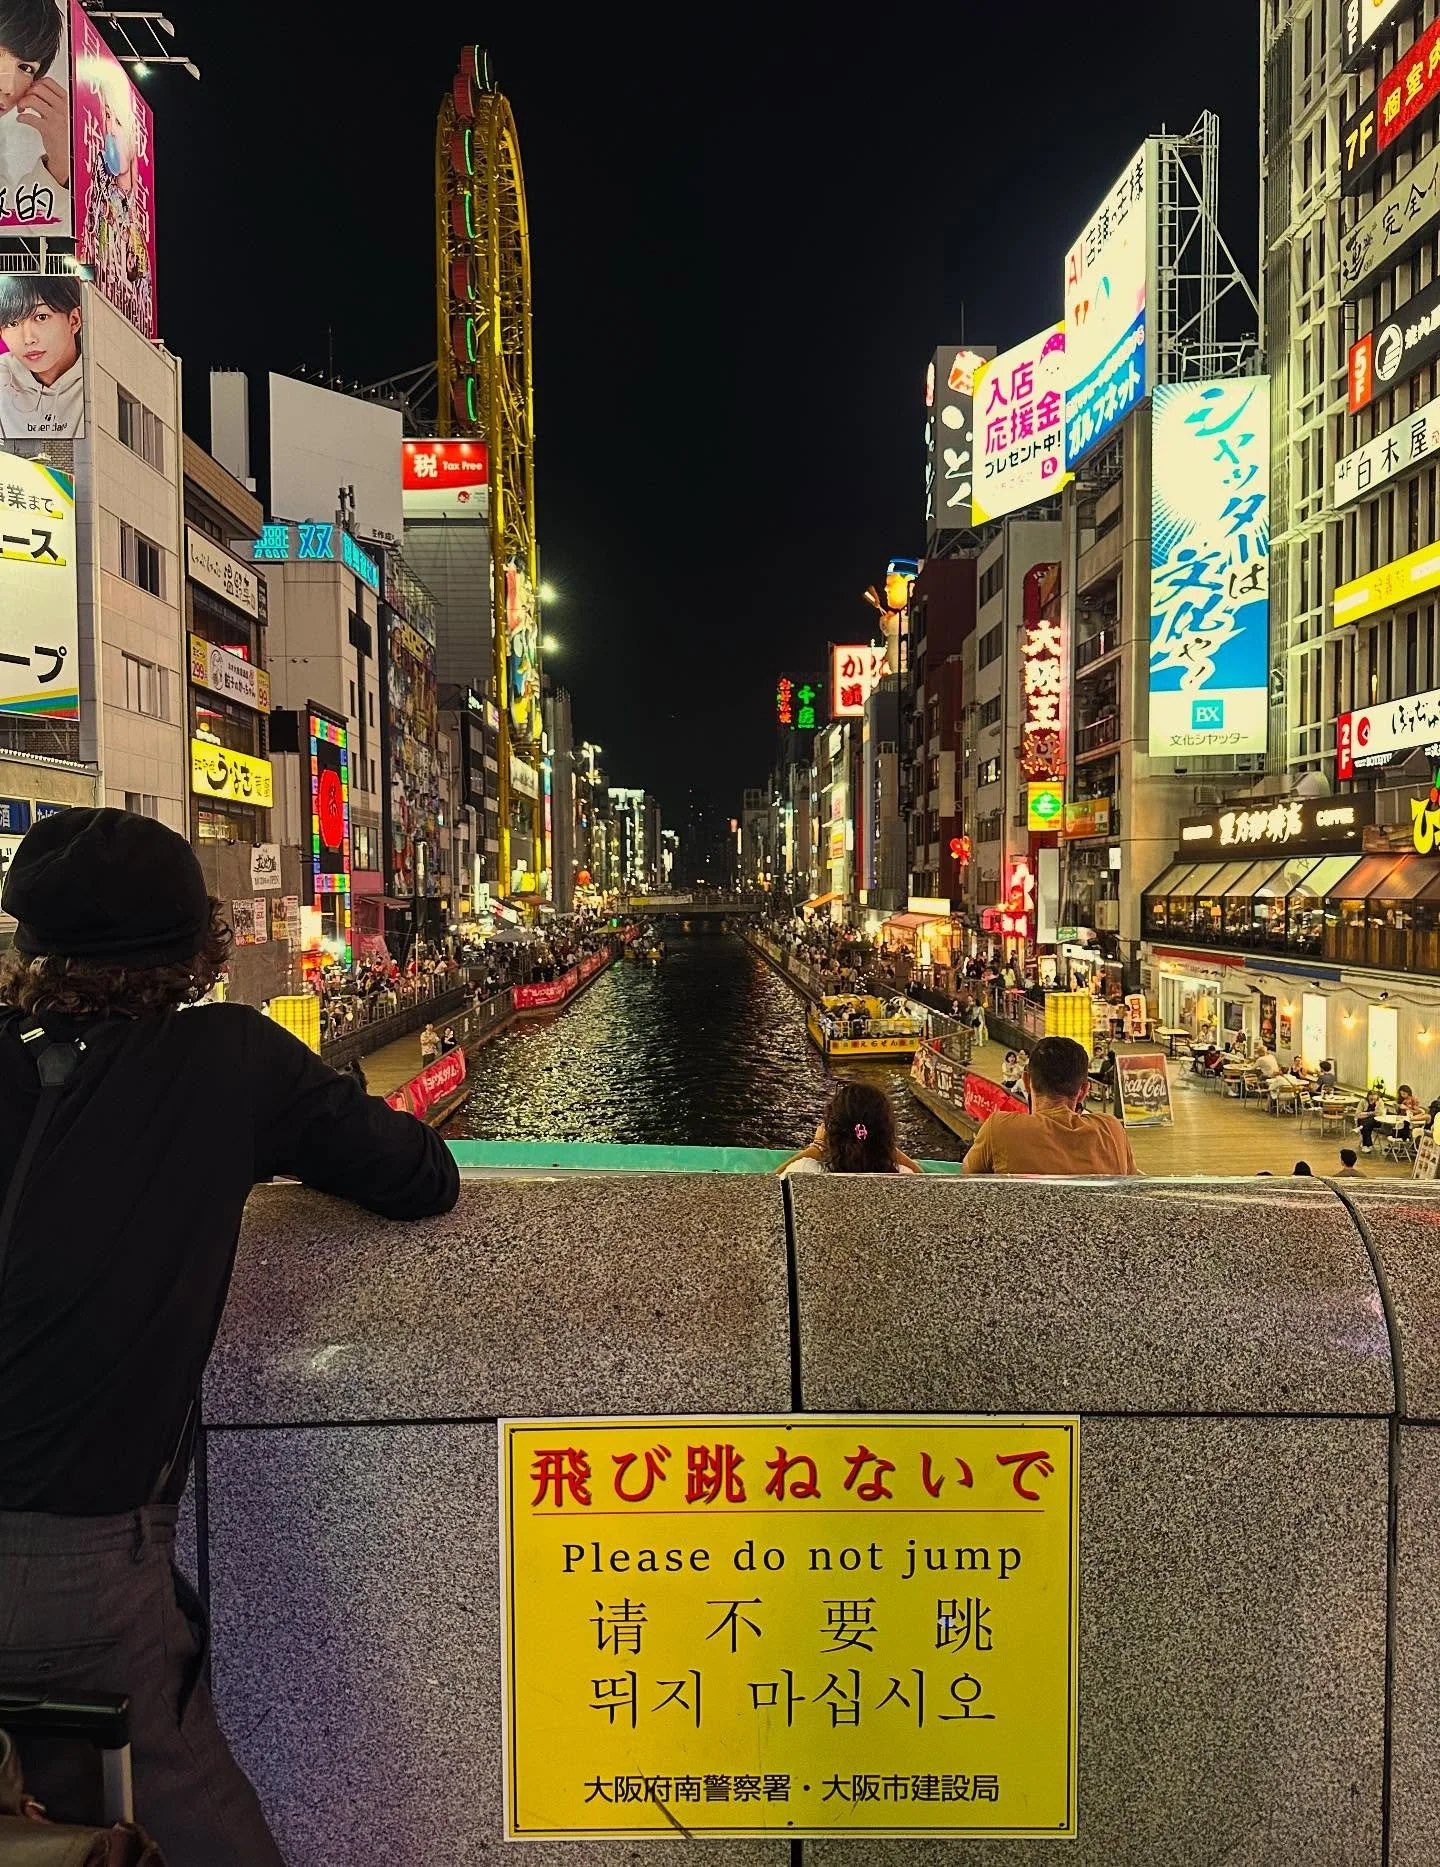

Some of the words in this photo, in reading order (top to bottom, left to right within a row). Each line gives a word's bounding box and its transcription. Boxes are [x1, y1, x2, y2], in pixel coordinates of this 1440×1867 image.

[1345, 110, 1374, 171] 7F
[985, 360, 1034, 417] 入店
[1354, 345, 1367, 403] 5F
[985, 390, 1061, 456] 応援金
[413, 453, 439, 478] 税
[442, 461, 460, 471] Tax
[461, 460, 483, 471] Free
[1337, 458, 1352, 480] 4F
[1357, 417, 1429, 491] 白木屋
[0, 480, 55, 513] 業まで
[1195, 706, 1221, 723] BX
[1341, 723, 1351, 771] 2F
[530, 1443, 1055, 1508] 飛び跳ねないで
[561, 1541, 710, 1573] Please
[733, 1540, 785, 1571] do
[808, 1542, 884, 1571] not
[901, 1539, 1022, 1580] jump
[588, 1669, 701, 1729] 뛰지
[747, 1668, 996, 1729] 마십시오
